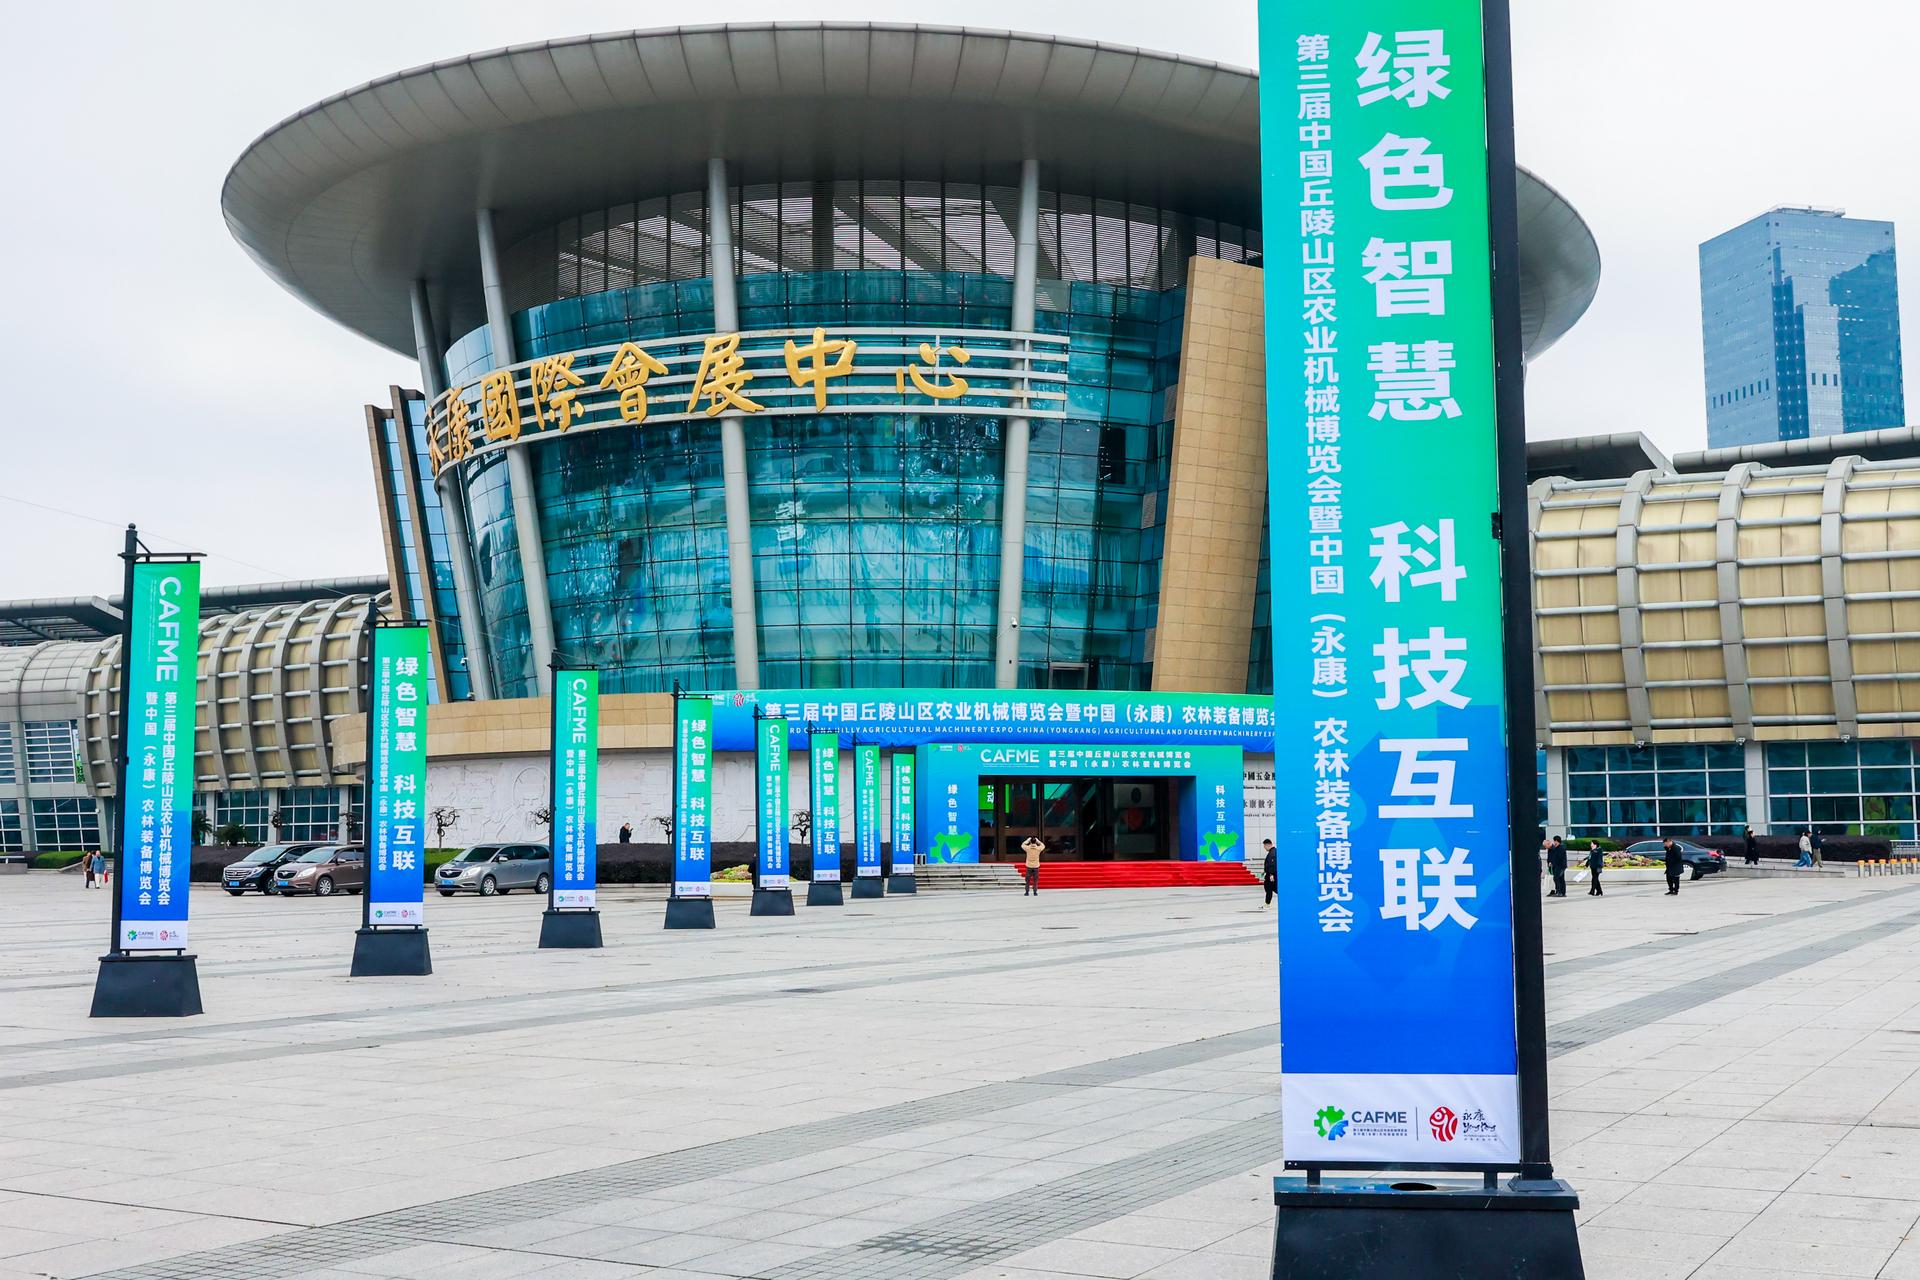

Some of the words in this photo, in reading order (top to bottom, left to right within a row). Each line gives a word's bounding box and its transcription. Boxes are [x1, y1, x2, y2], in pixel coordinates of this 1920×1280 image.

[1354, 29, 1463, 421] 绿色智慧
[1296, 33, 1353, 933] 第三届中国丘陵山区农业机械博览会暨中国（永康）农林装备博览会
[156, 576, 182, 682] CAFME
[394, 657, 419, 752] 绿色智慧
[572, 678, 587, 744] CAFME
[1369, 518, 1478, 931] 科技互联
[691, 720, 707, 782] 绿色智慧
[769, 724, 781, 772] CAFME
[980, 749, 1040, 763] CAFME
[157, 692, 178, 906] 第三届中国丘陵山区农业机械博览会
[392, 774, 416, 871] 科技互联
[690, 797, 705, 861] 科技互联
[823, 806, 836, 855] 科技互联
[1351, 1111, 1407, 1123] CAFME
